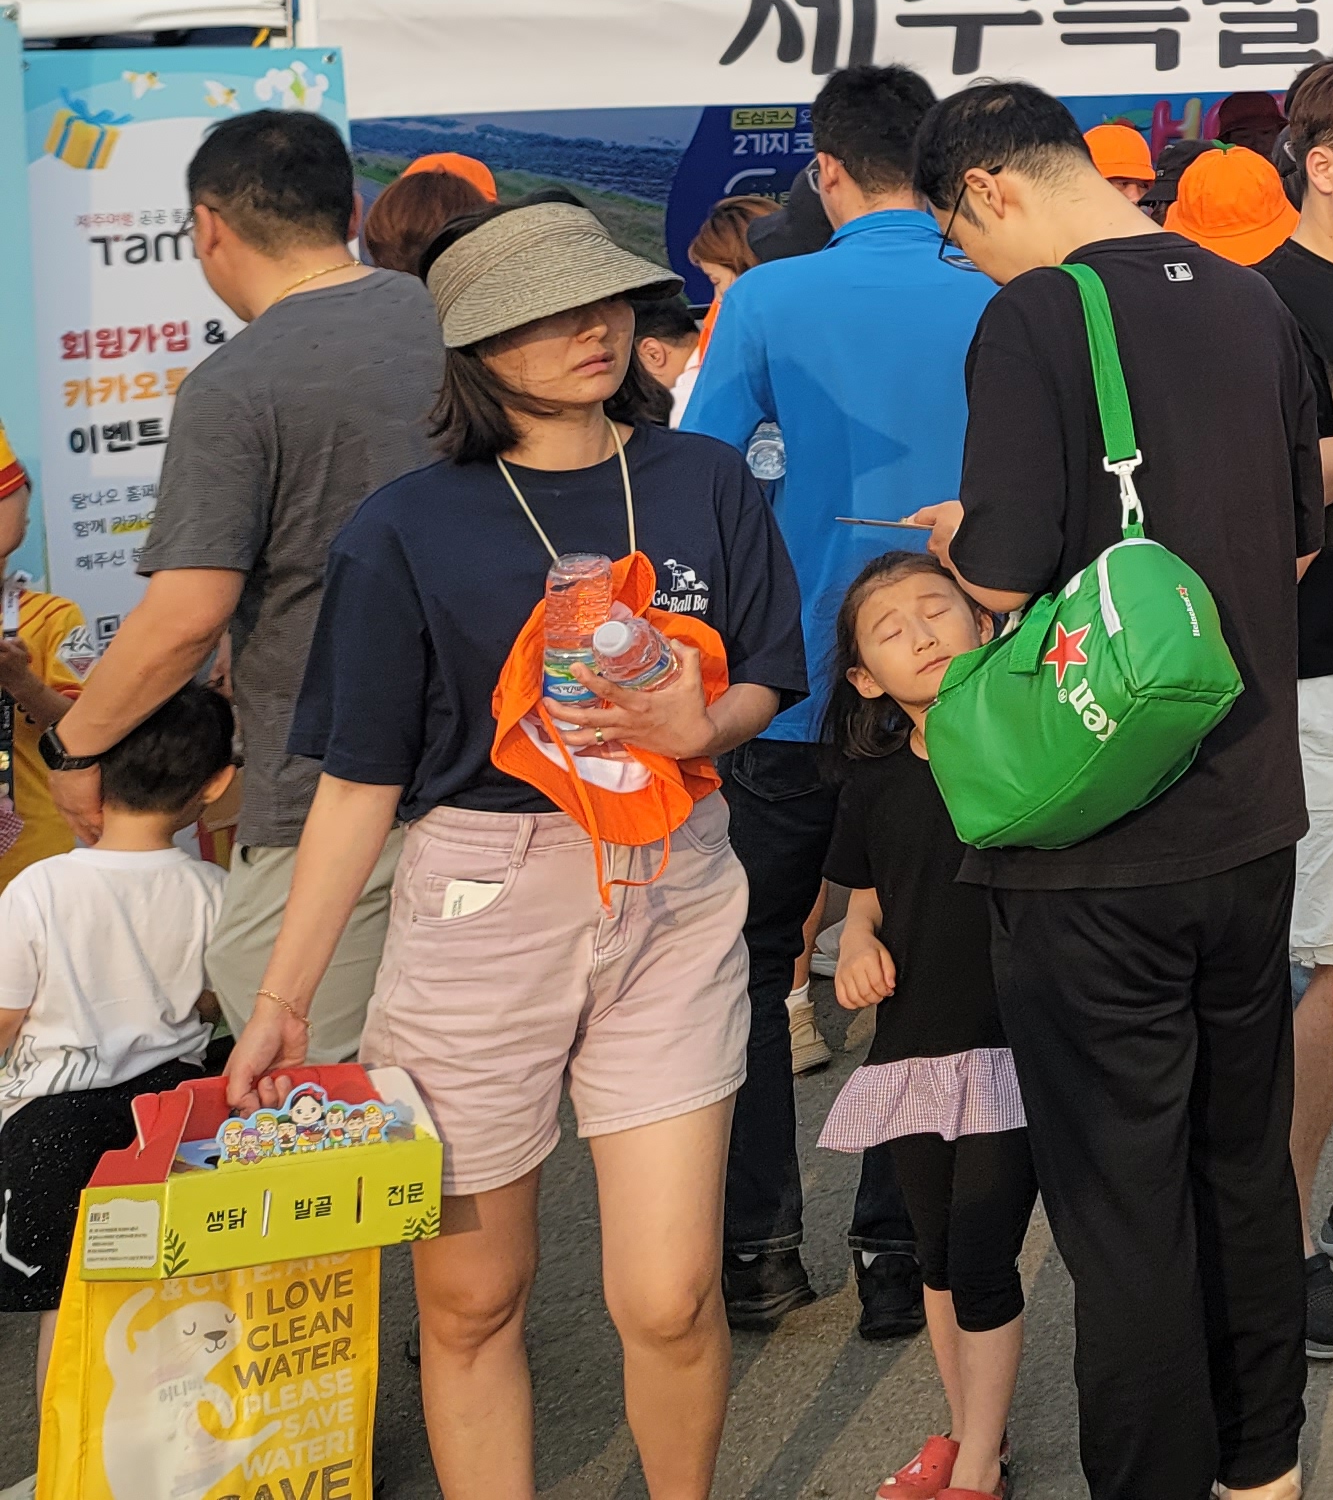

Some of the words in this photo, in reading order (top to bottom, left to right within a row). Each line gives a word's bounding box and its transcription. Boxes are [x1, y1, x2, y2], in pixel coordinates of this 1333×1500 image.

[735, 110, 796, 126] 도심코스
[733, 131, 790, 156] 2가지
[60, 319, 191, 360] 회원가입
[204, 319, 227, 345] &
[69, 417, 168, 455] 이벤트
[76, 549, 126, 571] 해주신
[668, 595, 691, 613] Ball
[1183, 596, 1201, 637] Heineken
[206, 1206, 248, 1233] 생닭
[294, 1194, 334, 1221] 발골
[387, 1182, 426, 1207] 전문
[246, 1291, 254, 1320] I
[266, 1268, 355, 1317] LOVE
[246, 1303, 354, 1353] CLEAN
[232, 1336, 358, 1390] WATER.
[242, 1367, 356, 1422] PLEASE
[281, 1397, 356, 1440] SAVE
[240, 1426, 356, 1482] WATER!
[217, 1458, 355, 1500] AVE
